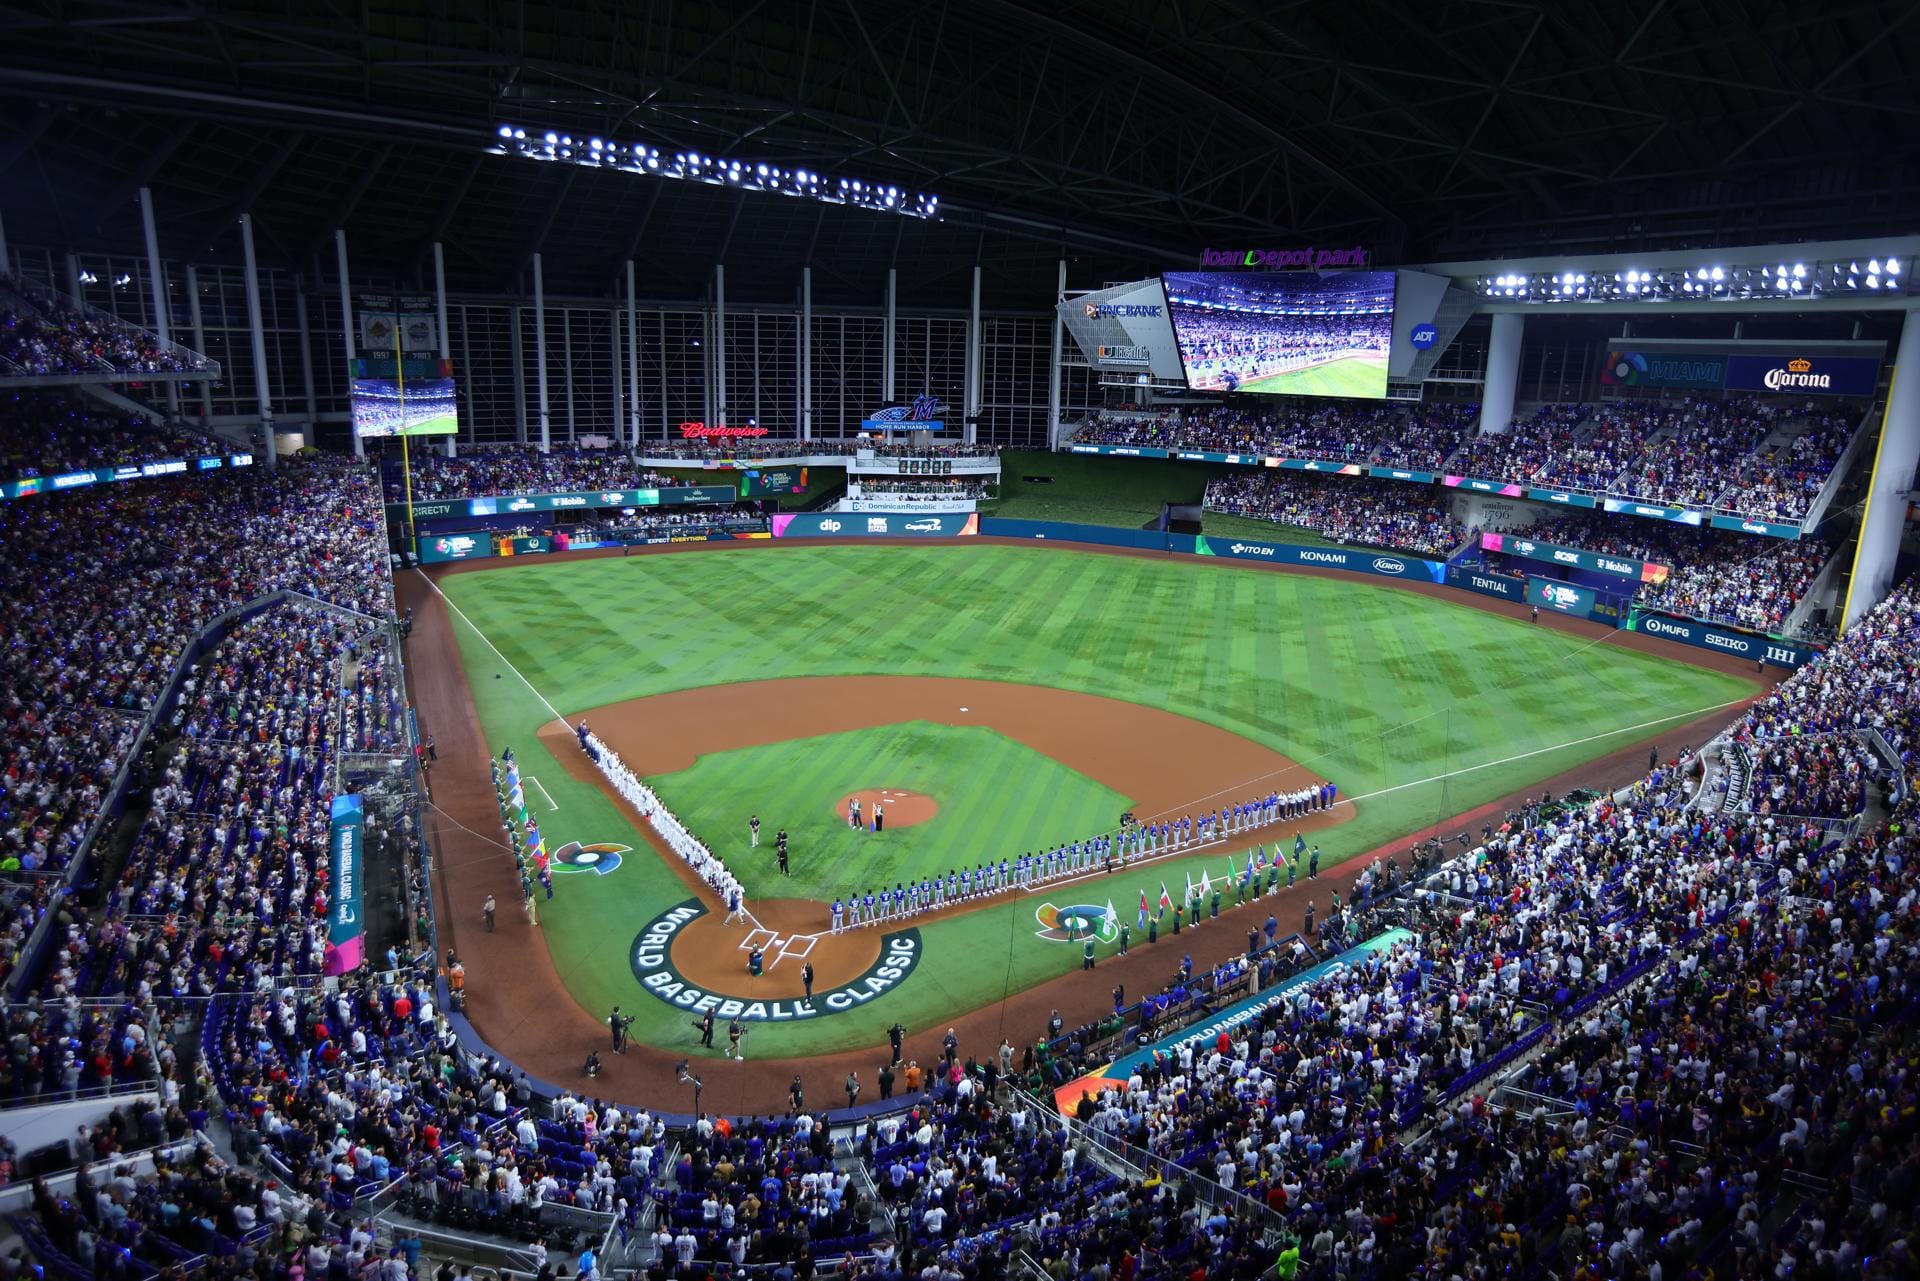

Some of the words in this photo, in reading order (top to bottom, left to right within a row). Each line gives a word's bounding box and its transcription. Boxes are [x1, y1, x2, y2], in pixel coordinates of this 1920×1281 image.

[1315, 246, 1368, 269] park
[1413, 331, 1436, 343] ADT
[1650, 361, 1722, 381] MIAMI
[1764, 367, 1830, 390] Corona
[680, 422, 768, 438] Budweiser
[561, 497, 586, 506] Mobile
[412, 505, 451, 516] DIRECTV
[820, 519, 841, 533] dip
[1742, 522, 1767, 533] Google
[647, 537, 670, 545] EXPECT
[671, 535, 708, 544] EVERYTHING
[1300, 551, 1346, 564] KONAMI
[1374, 559, 1404, 572] Kowa
[1553, 551, 1579, 564] SCSK
[1605, 560, 1633, 575] Mobile
[1472, 576, 1508, 594] TENTIAL
[1661, 623, 1690, 639] MUFG
[1705, 633, 1749, 652] SEIKO
[1765, 645, 1796, 664] IHI
[341, 831, 353, 849] WORLD
[340, 849, 353, 876] BASEBALL
[340, 876, 352, 899] CLASSIC
[637, 906, 700, 967] WORLD
[826, 937, 915, 1008] CLASSIC
[644, 971, 817, 1019] BASEBALL
